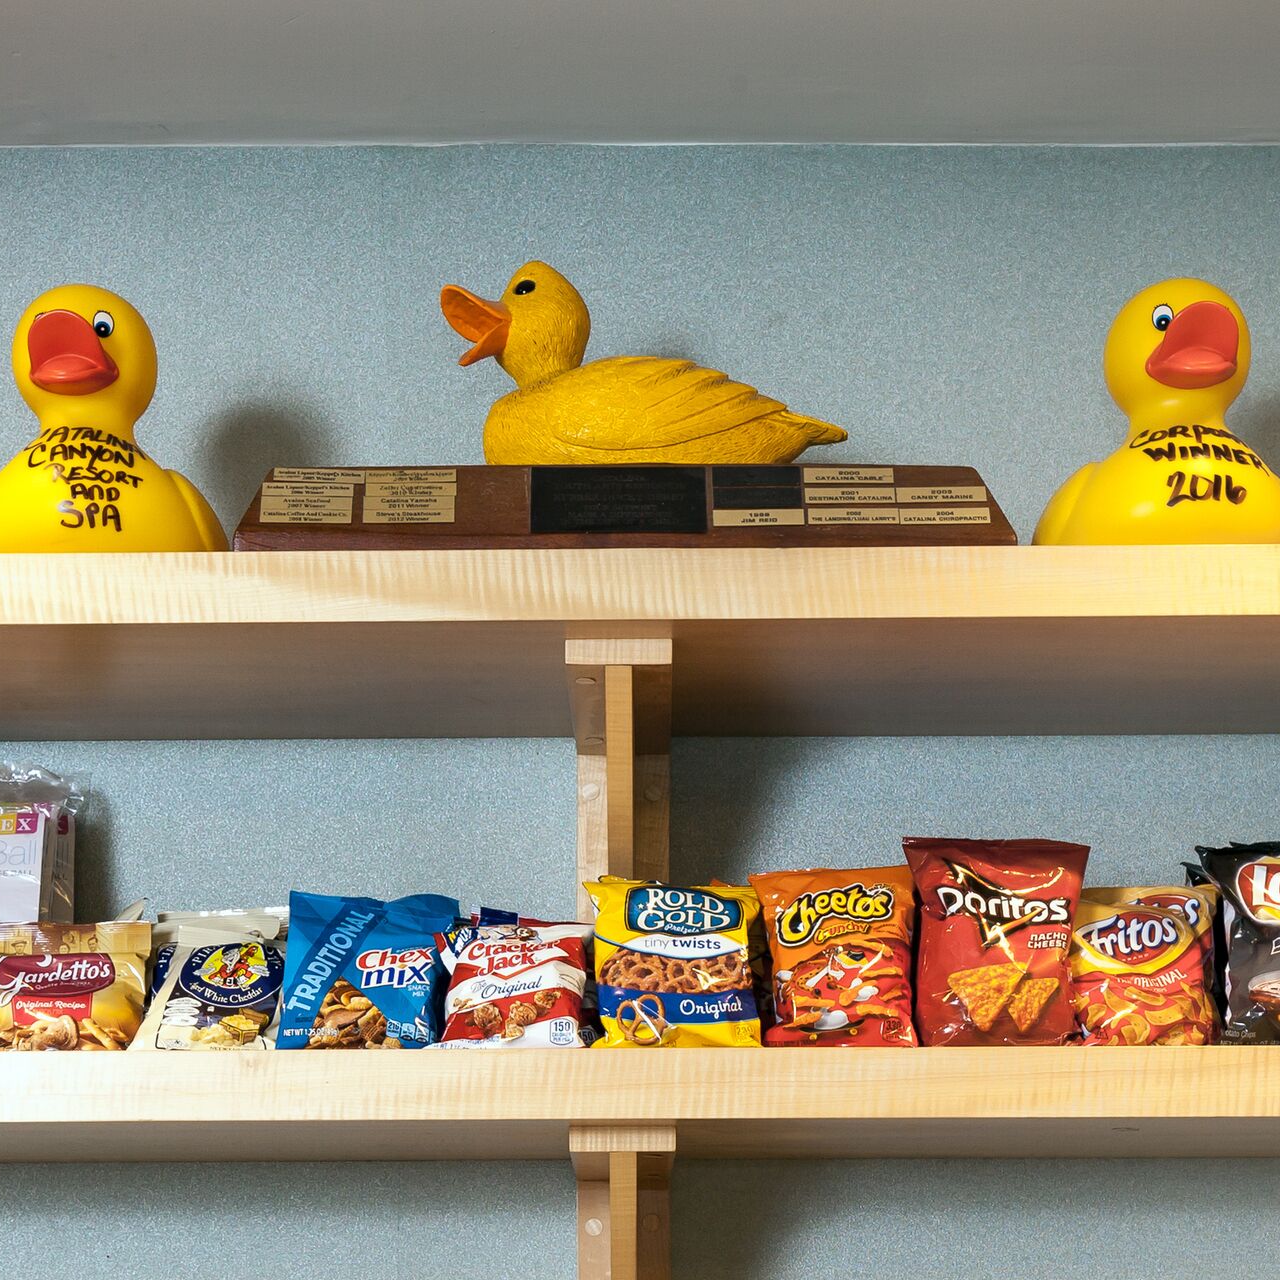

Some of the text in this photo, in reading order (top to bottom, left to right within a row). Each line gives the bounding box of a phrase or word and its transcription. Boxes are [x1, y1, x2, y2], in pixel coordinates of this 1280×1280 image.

[28, 443, 135, 469] CANYON
[1143, 442, 1270, 477] WINNER
[43, 463, 143, 488] RESORT
[70, 483, 120, 502] AND
[1166, 471, 1247, 507] 2016
[56, 500, 122, 532] SPA
[779, 884, 888, 941] Cheetos
[936, 886, 1070, 922] Doritos
[637, 908, 730, 931] GOLD
[644, 938, 721, 950] tiny twists
[1027, 941, 1068, 950] CHEESE
[1030, 933, 1067, 942] NACHO
[1080, 912, 1178, 958] Fritos
[288, 909, 374, 1013] TRADITIONAL
[357, 947, 433, 969] Chex
[468, 940, 560, 960] Cracker
[363, 963, 431, 988] mix
[478, 953, 536, 976] Jack
[204, 987, 263, 1004] White Cheddar
[481, 976, 543, 1000] Original
[16, 1000, 86, 1011] Original Recipe
[680, 998, 743, 1019] Original
[554, 1021, 571, 1031] 150
